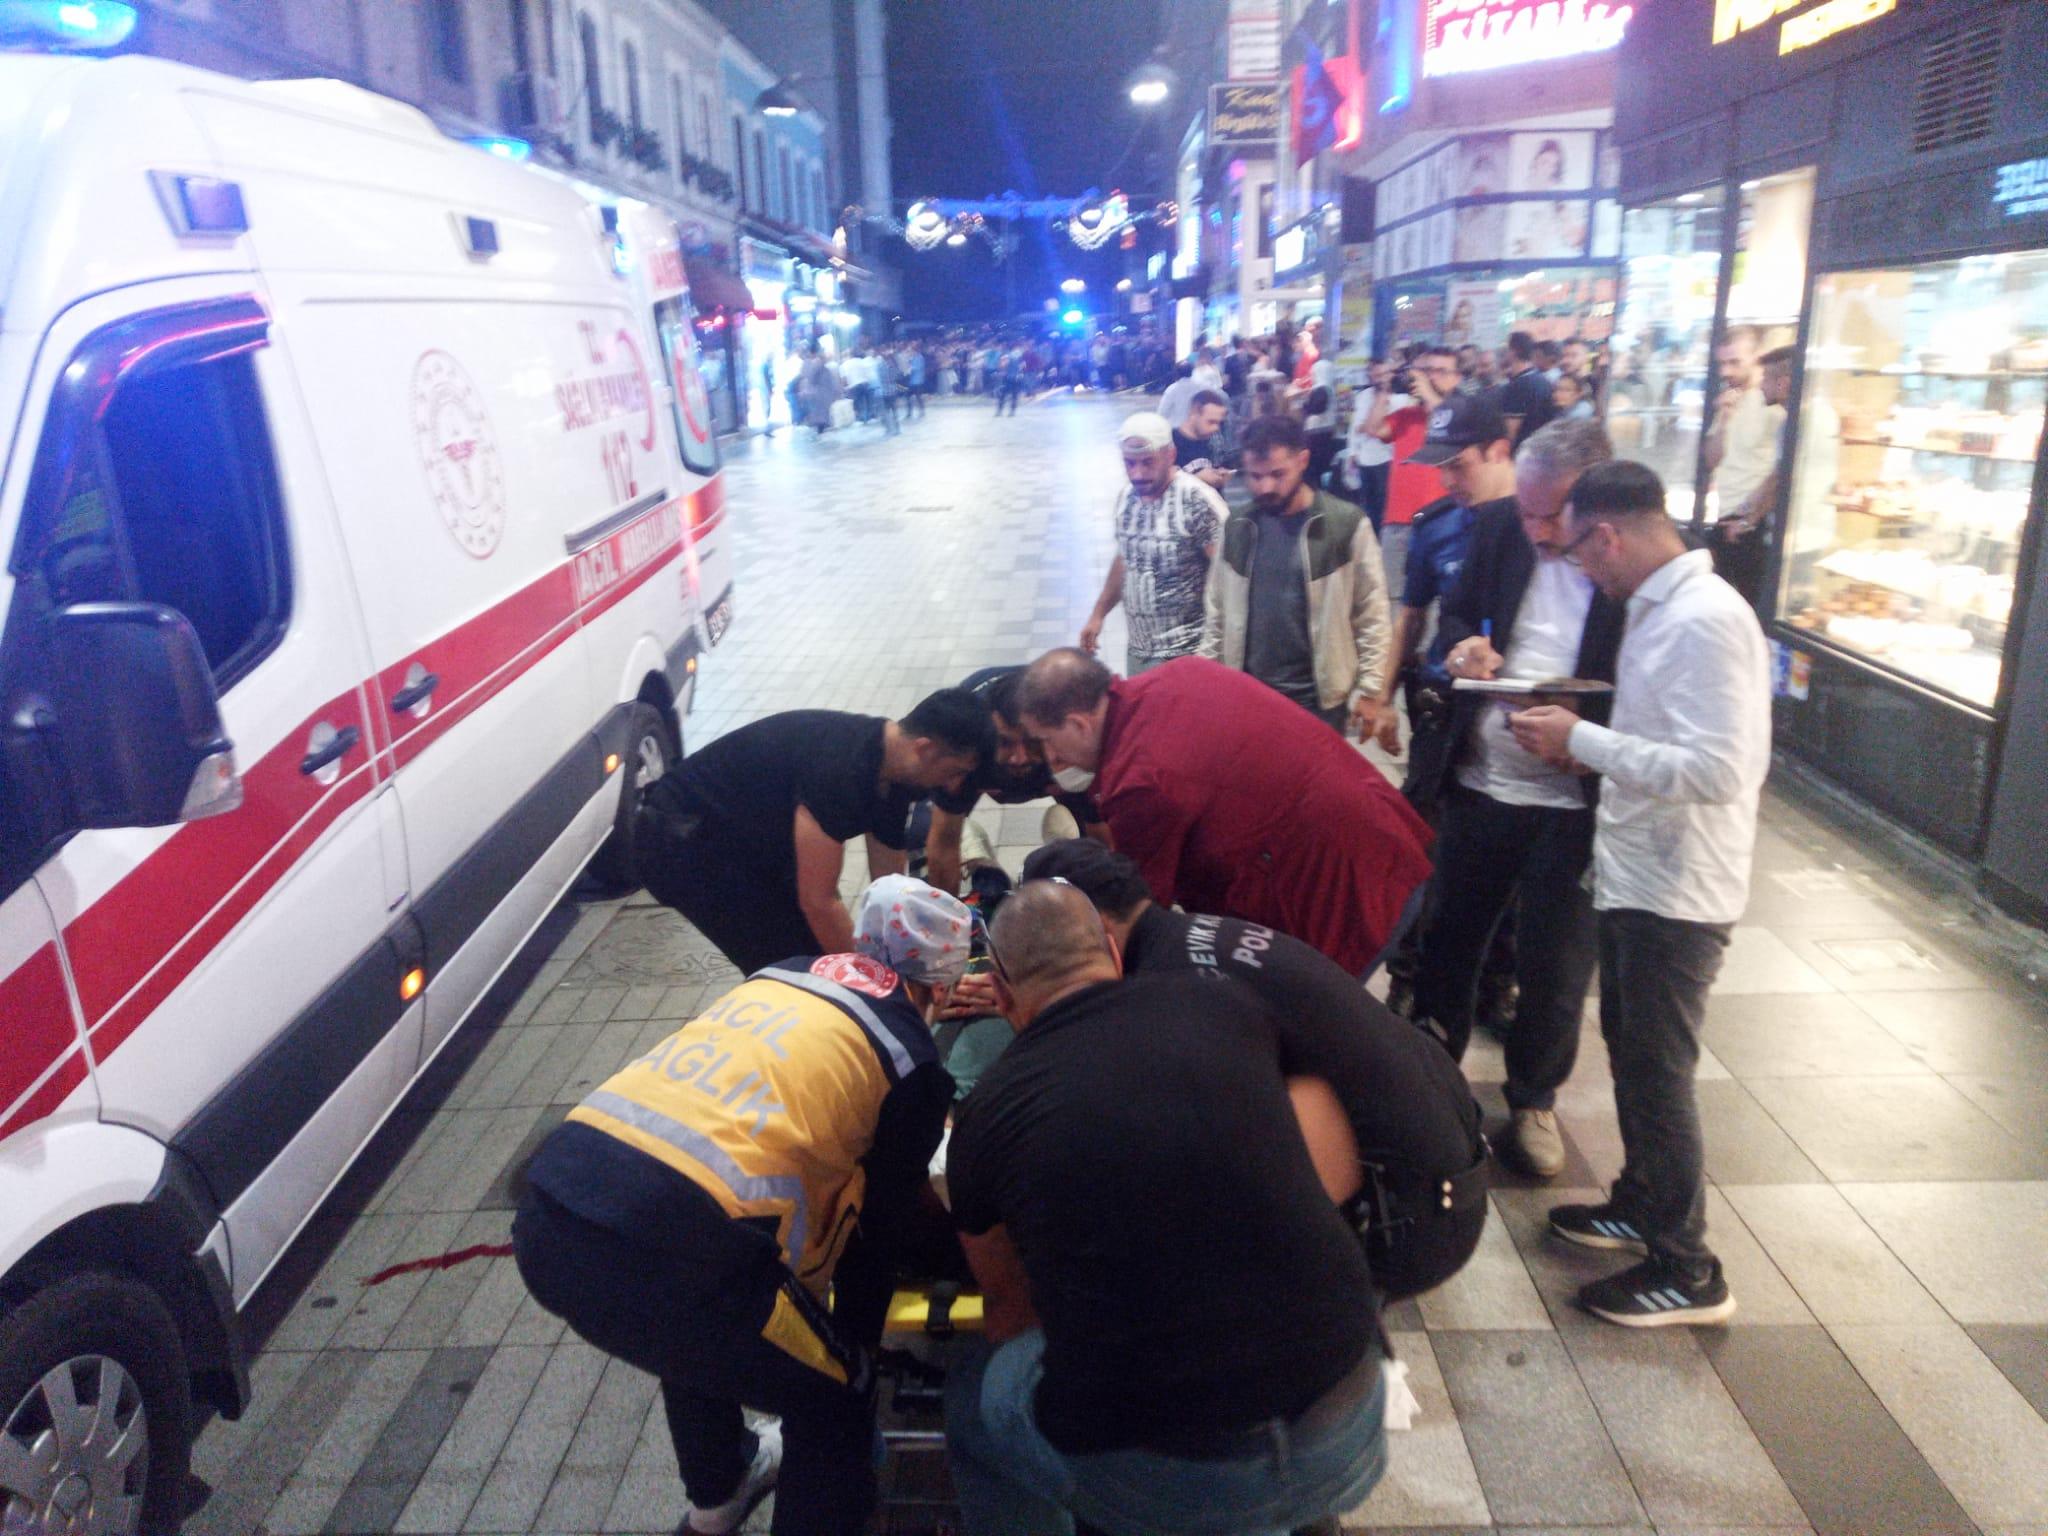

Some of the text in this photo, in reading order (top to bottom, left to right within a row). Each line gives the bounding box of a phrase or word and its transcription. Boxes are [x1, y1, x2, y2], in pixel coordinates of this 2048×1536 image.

[599, 430, 639, 508] 112
[576, 545, 621, 603] ACİL
[698, 996, 804, 1062] ACİL
